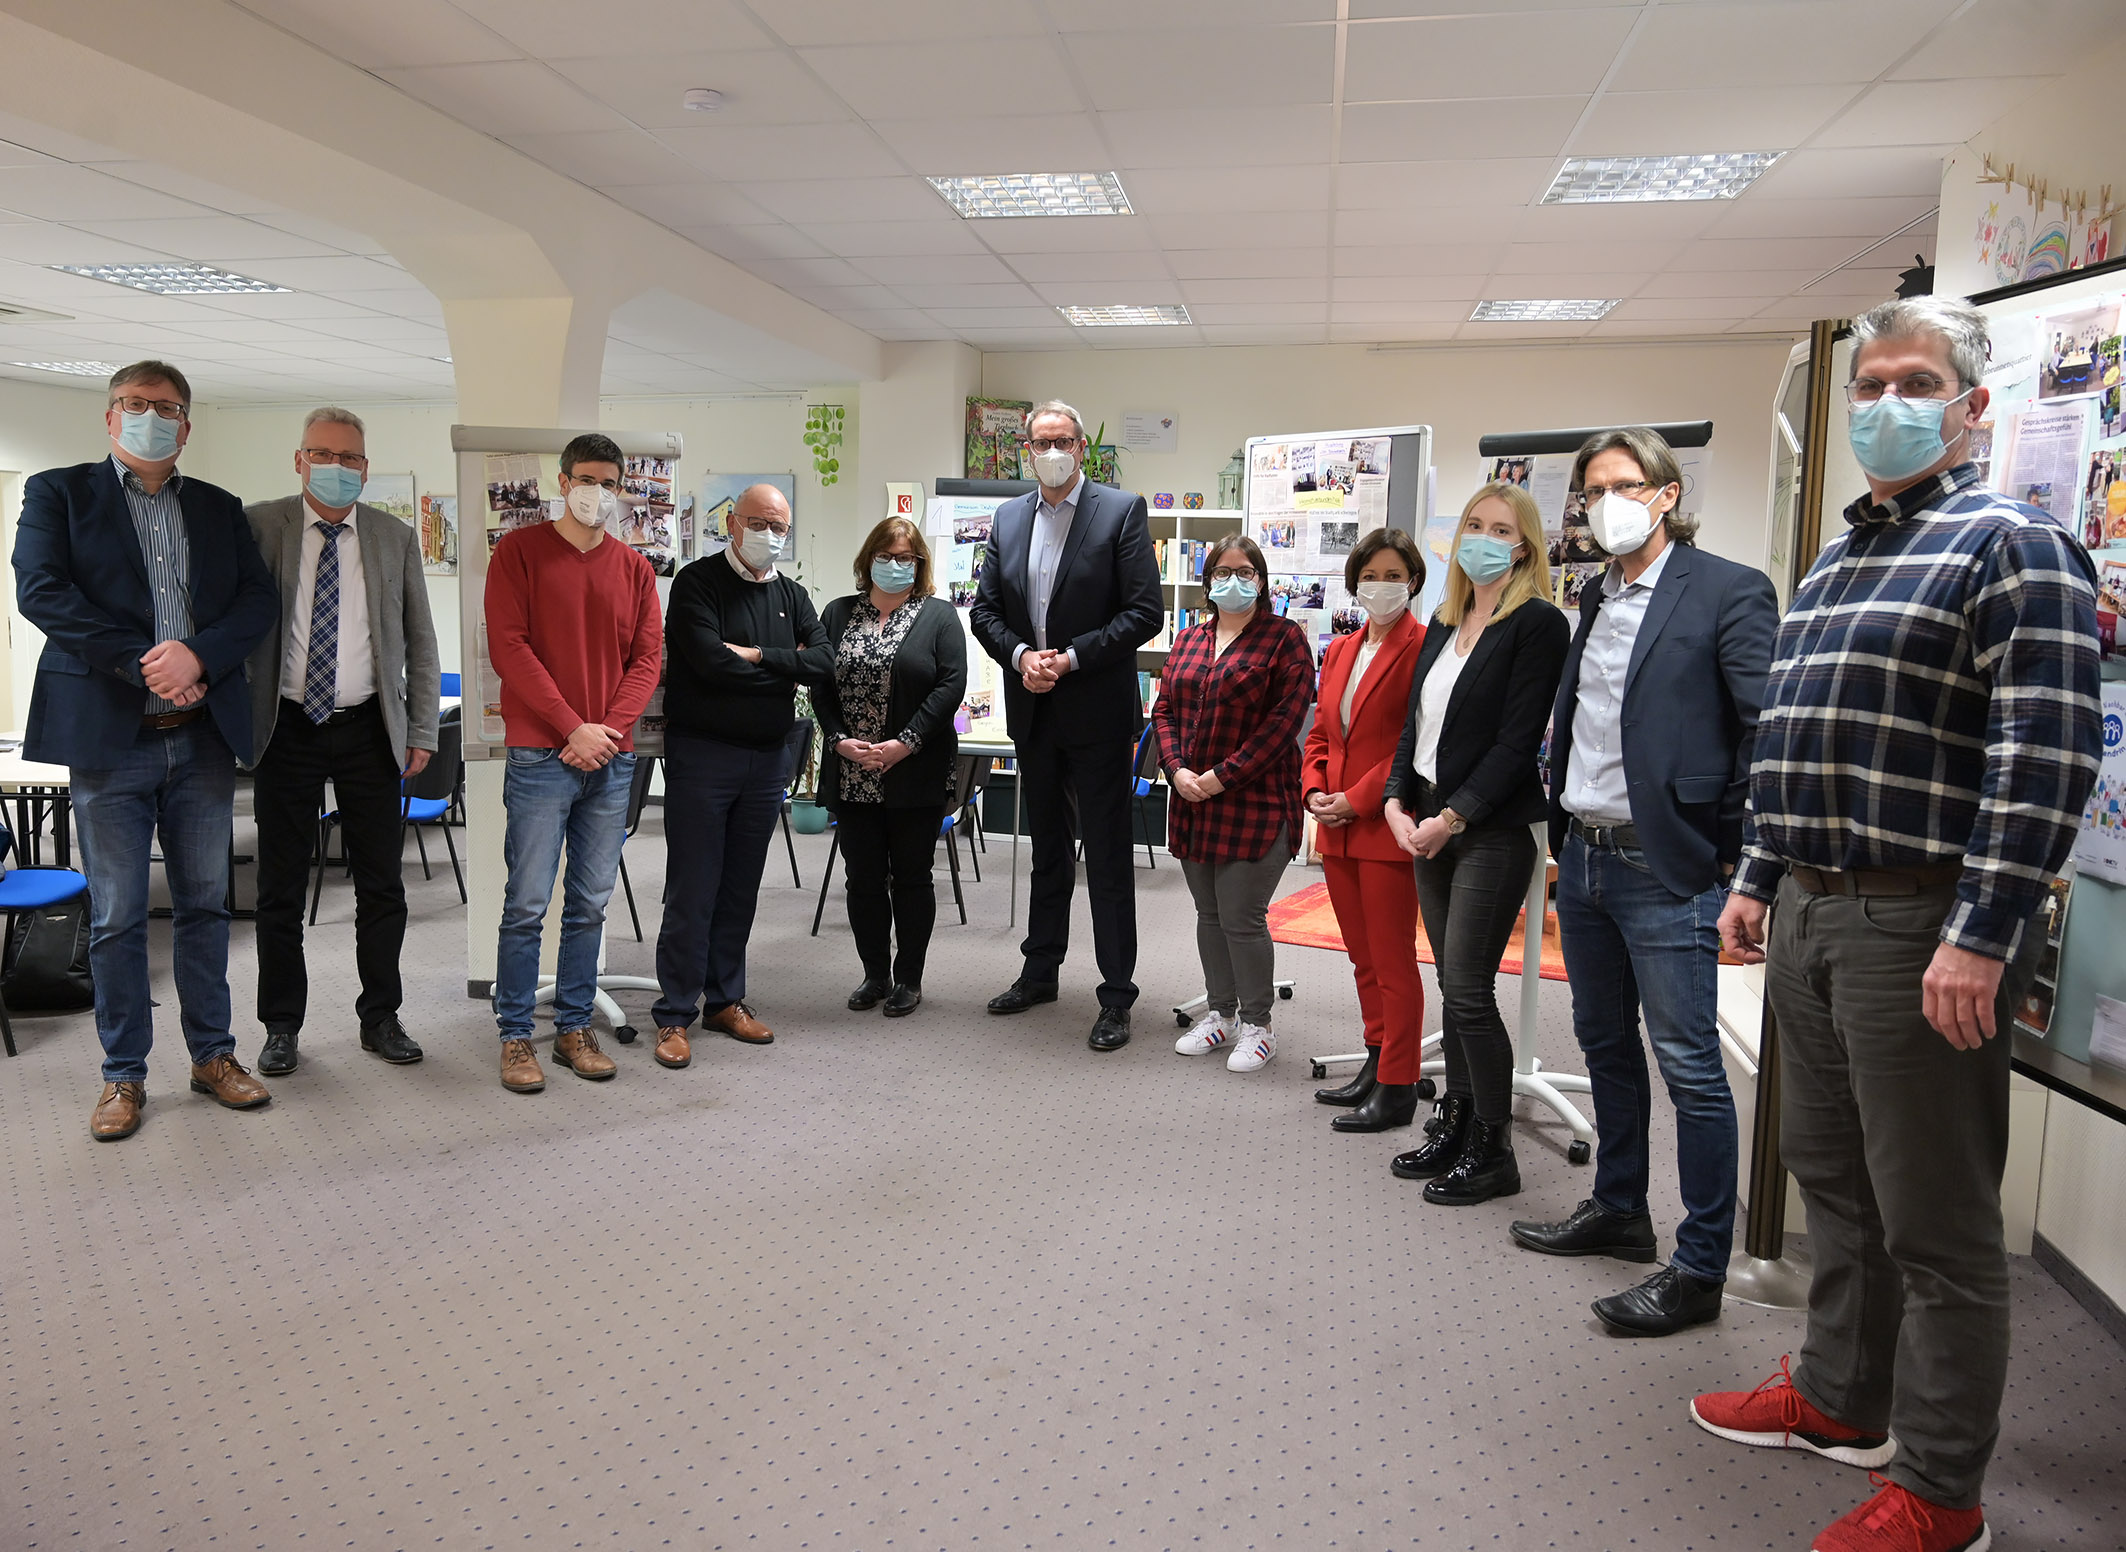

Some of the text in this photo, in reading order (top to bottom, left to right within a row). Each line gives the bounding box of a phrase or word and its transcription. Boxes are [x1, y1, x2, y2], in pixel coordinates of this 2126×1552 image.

[1679, 460, 1700, 497] 5
[931, 504, 943, 530] 1
[2103, 700, 2126, 713] Nachbar
[2102, 746, 2126, 758] endrin
